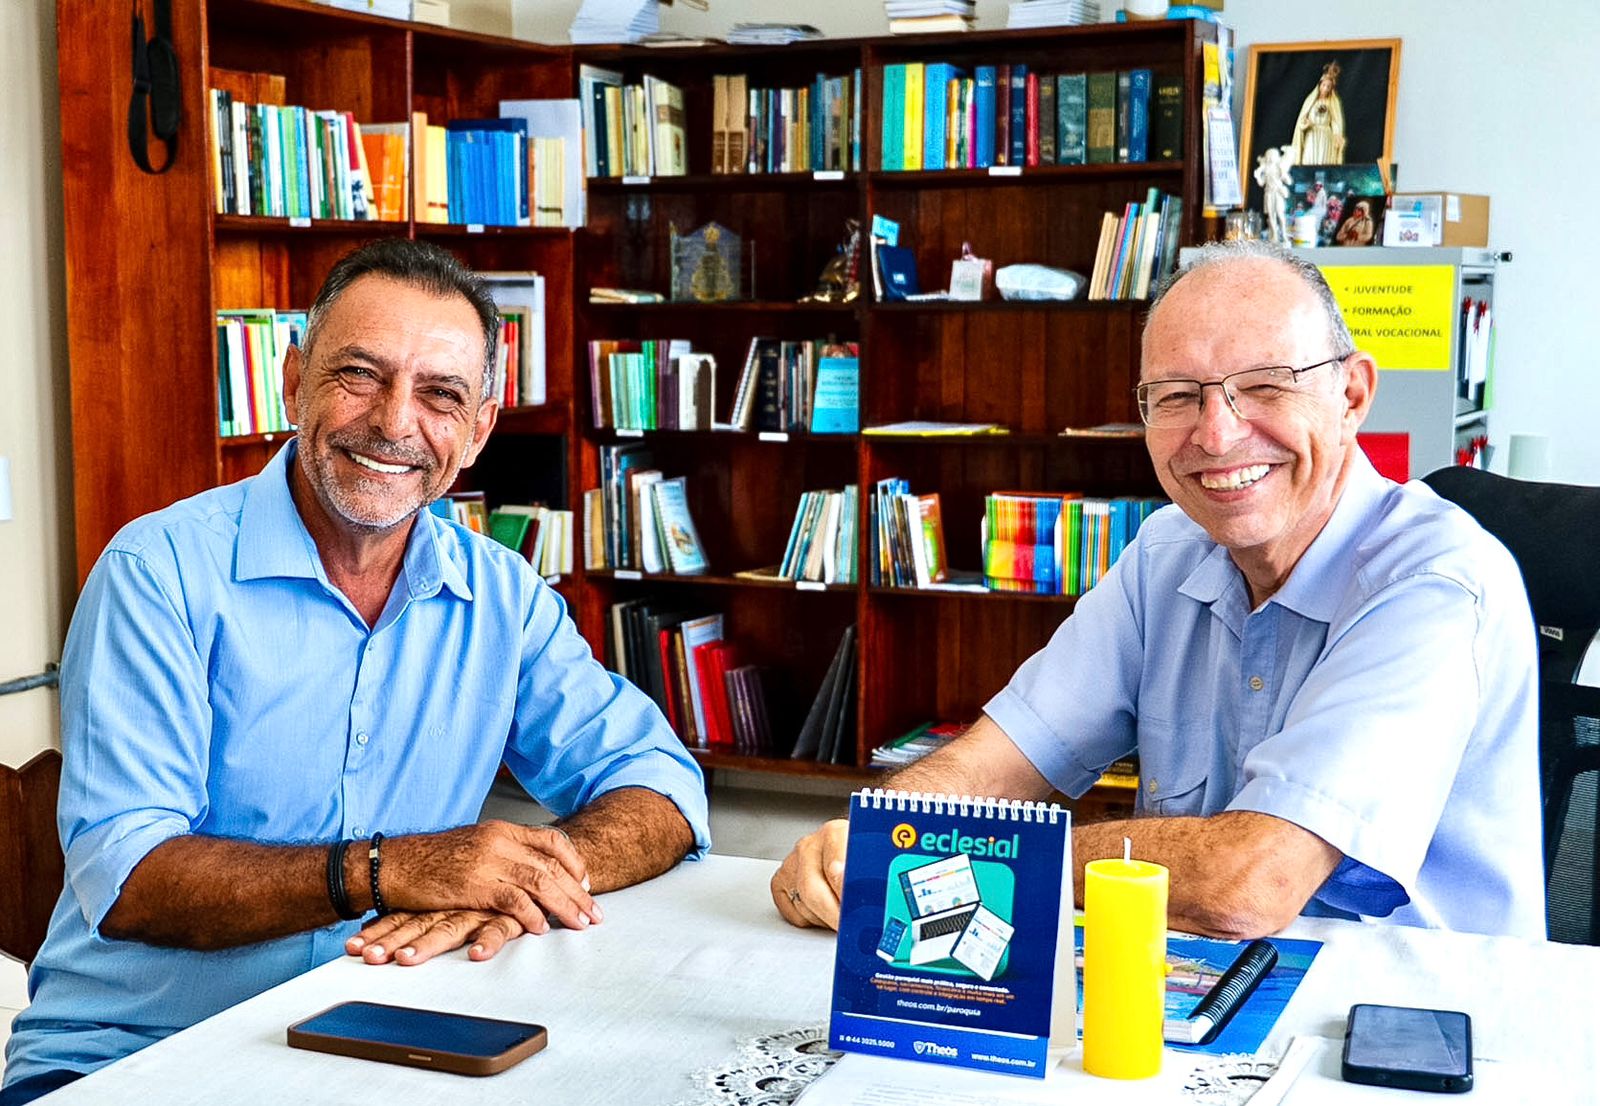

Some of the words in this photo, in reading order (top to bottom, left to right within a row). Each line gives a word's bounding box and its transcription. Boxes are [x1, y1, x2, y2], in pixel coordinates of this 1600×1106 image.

[1353, 285, 1412, 294] JUVENTUDE
[1352, 305, 1412, 317] FORMAÇÃO
[1376, 329, 1442, 337] VOCACIONAL
[920, 828, 1019, 859] eclesial
[897, 1000, 981, 1016] theos.com.br/paroquia
[971, 1053, 1037, 1068] www.theos.com.br
